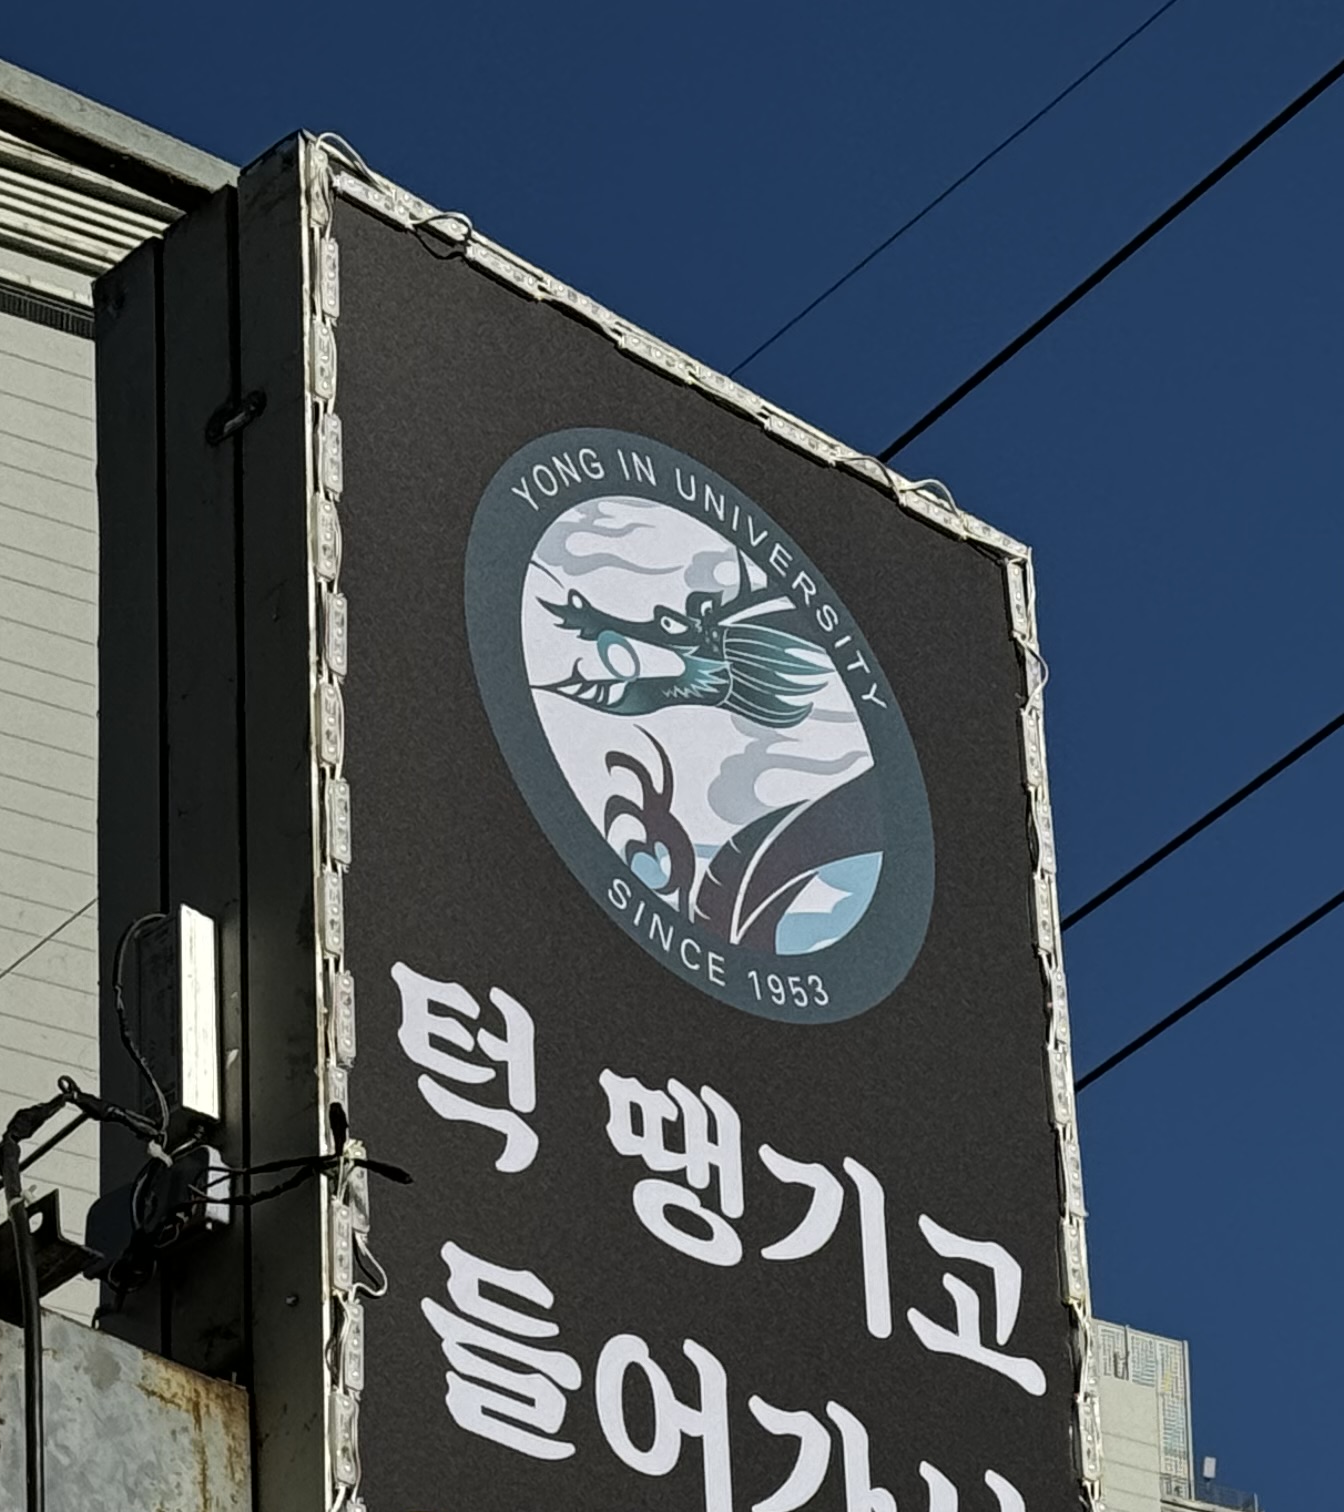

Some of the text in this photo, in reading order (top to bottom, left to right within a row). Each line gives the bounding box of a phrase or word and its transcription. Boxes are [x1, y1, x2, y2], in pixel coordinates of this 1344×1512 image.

[511, 448, 887, 709] YONG IN UNIVERSITY
[608, 878, 830, 1008] SINCE 1953
[391, 961, 1047, 1396] 턱 땡기고
